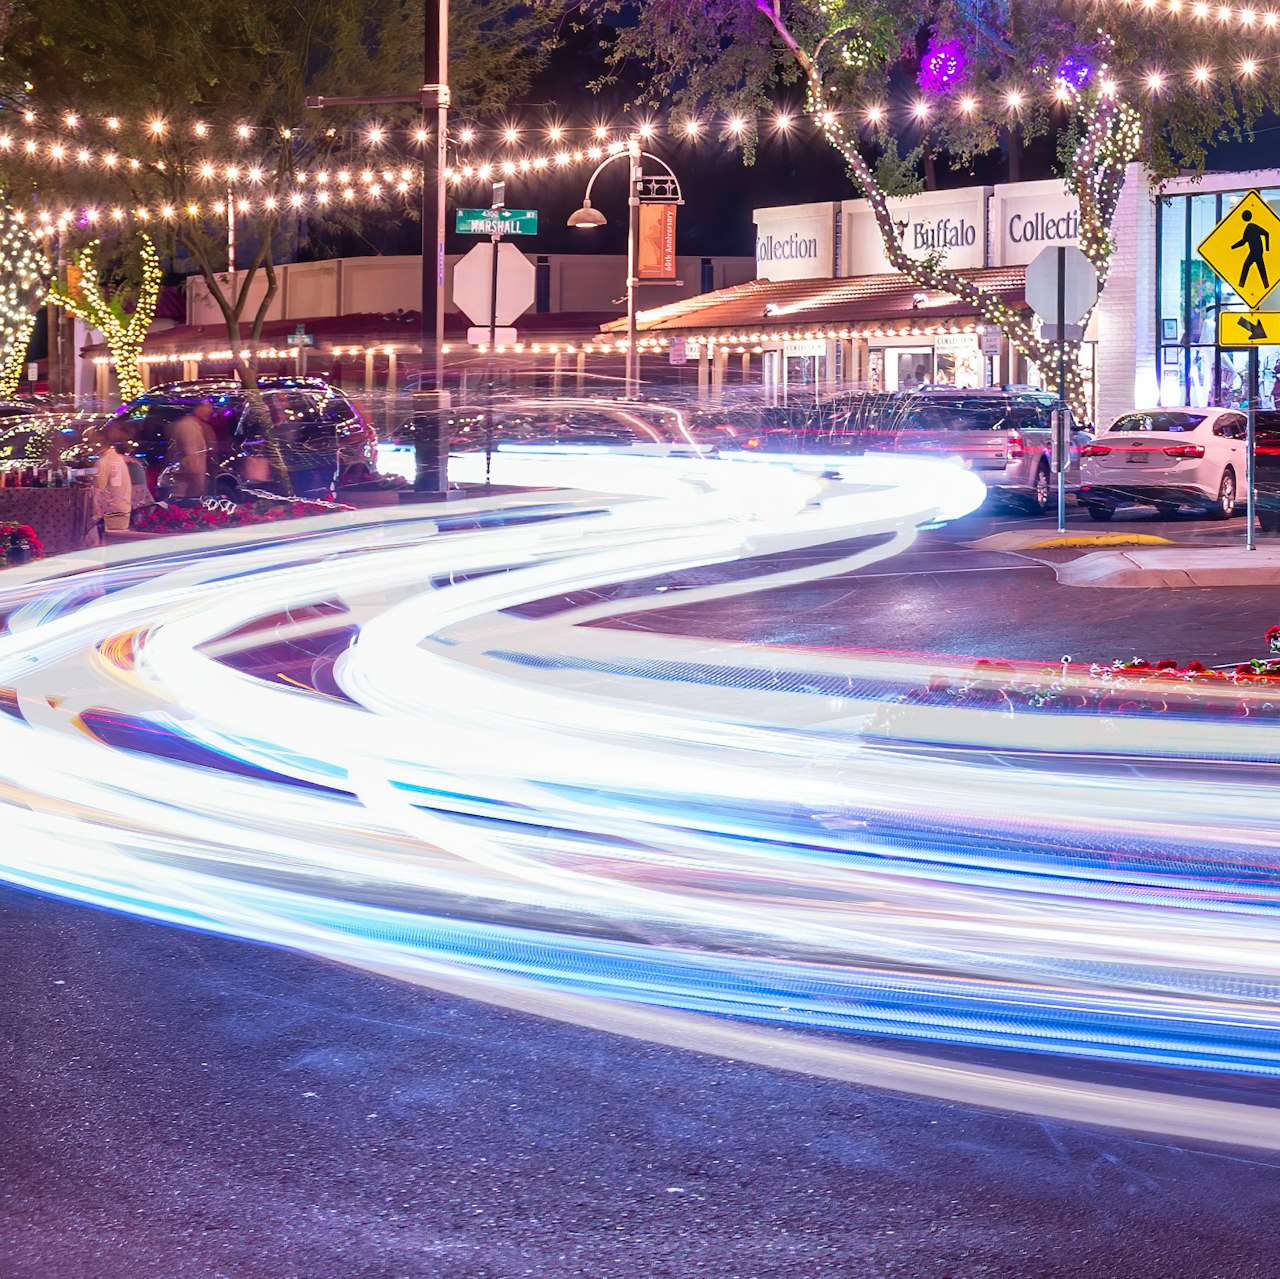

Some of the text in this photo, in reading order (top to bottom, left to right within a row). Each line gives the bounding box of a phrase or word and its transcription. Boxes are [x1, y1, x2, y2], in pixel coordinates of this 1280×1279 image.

[470, 220, 523, 233] MARSHALL
[664, 210, 674, 271] 60th Anniversary
[914, 219, 976, 250] Buffalo
[1009, 209, 1080, 243] Collecti
